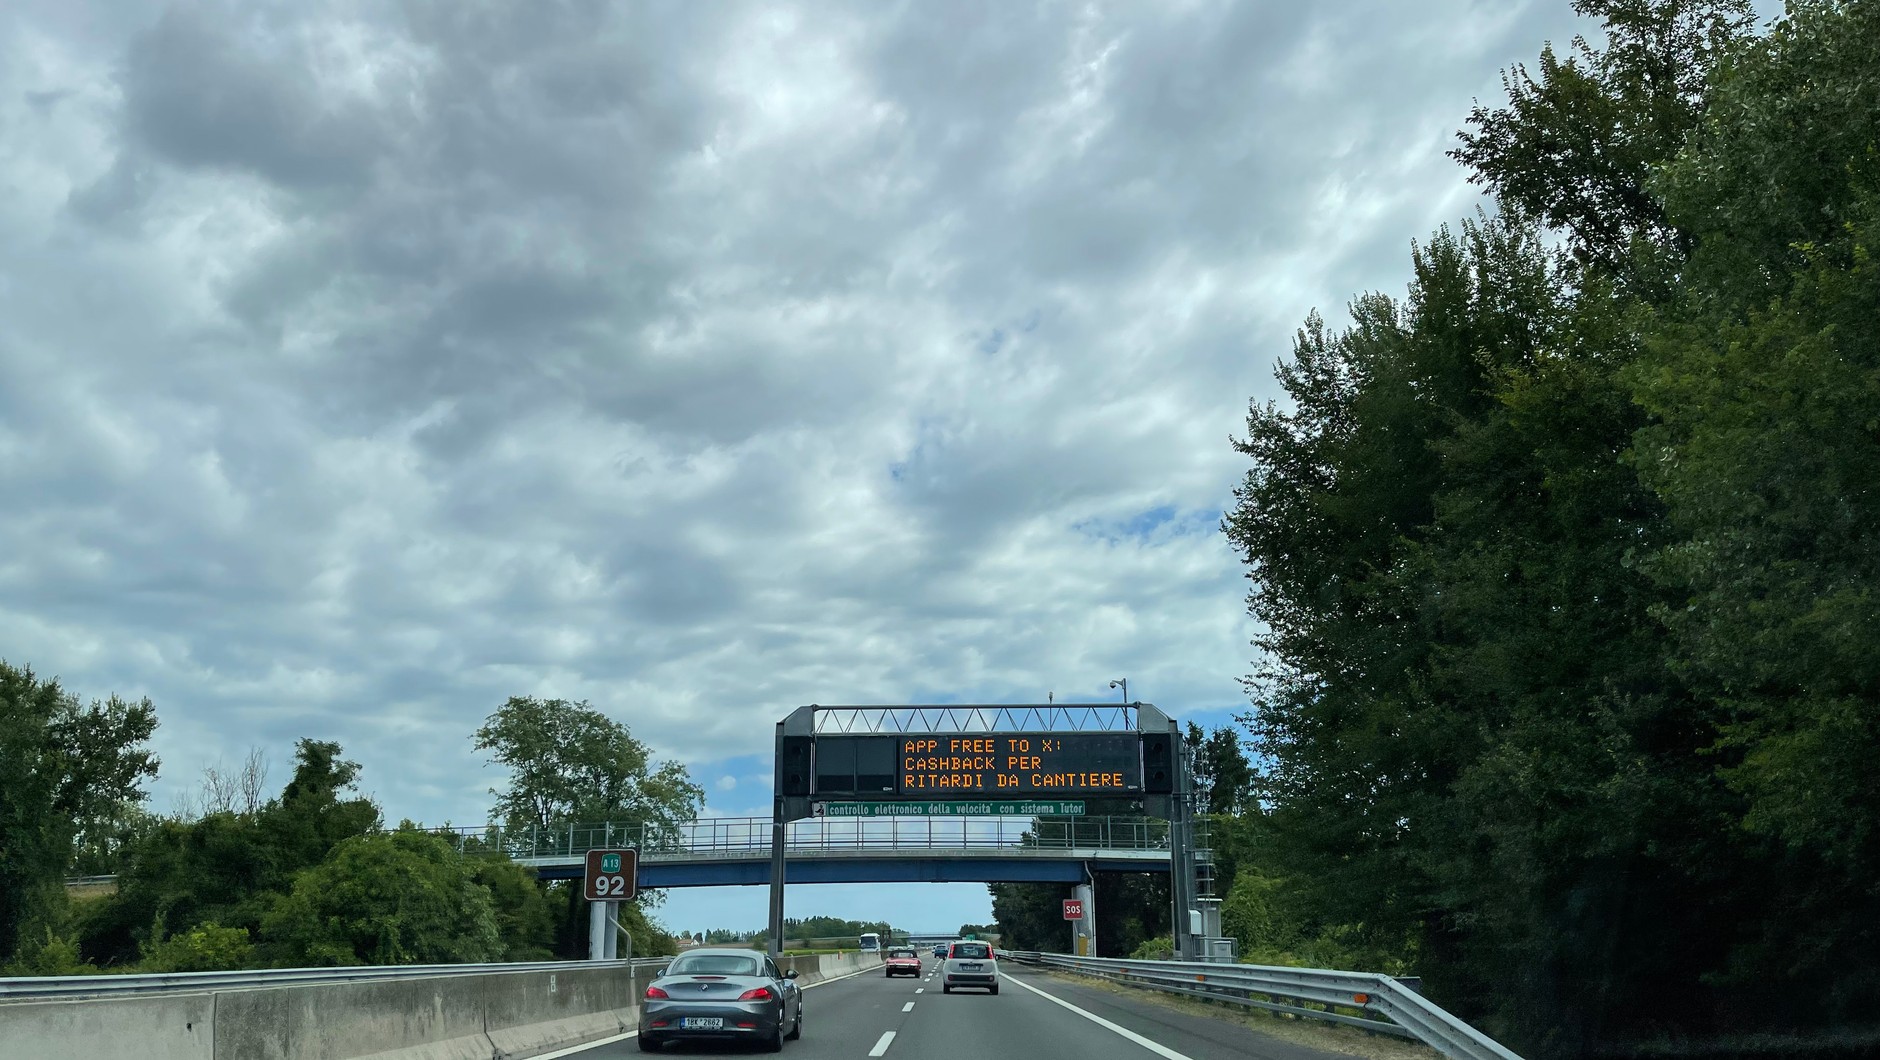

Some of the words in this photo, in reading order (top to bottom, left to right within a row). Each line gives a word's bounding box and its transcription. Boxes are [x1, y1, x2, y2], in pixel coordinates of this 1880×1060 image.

[905, 739, 938, 753] APP
[950, 739, 995, 753] FREE
[1008, 739, 1030, 753] TO
[905, 757, 995, 770] CASHBACK
[1008, 757, 1042, 770] PER
[905, 774, 982, 787] RITARDI
[997, 774, 1019, 787] DA
[1032, 773, 1123, 787] CANTIERE
[829, 804, 869, 815] controllo
[874, 804, 923, 815] elettronico
[928, 803, 951, 814] della
[999, 804, 1015, 814] con
[1020, 803, 1054, 814] sistema
[1060, 803, 1082, 814] Tutor
[603, 859, 608, 868] A
[610, 859, 619, 868] 13
[595, 876, 625, 896] 92
[1066, 905, 1081, 914] SOS
